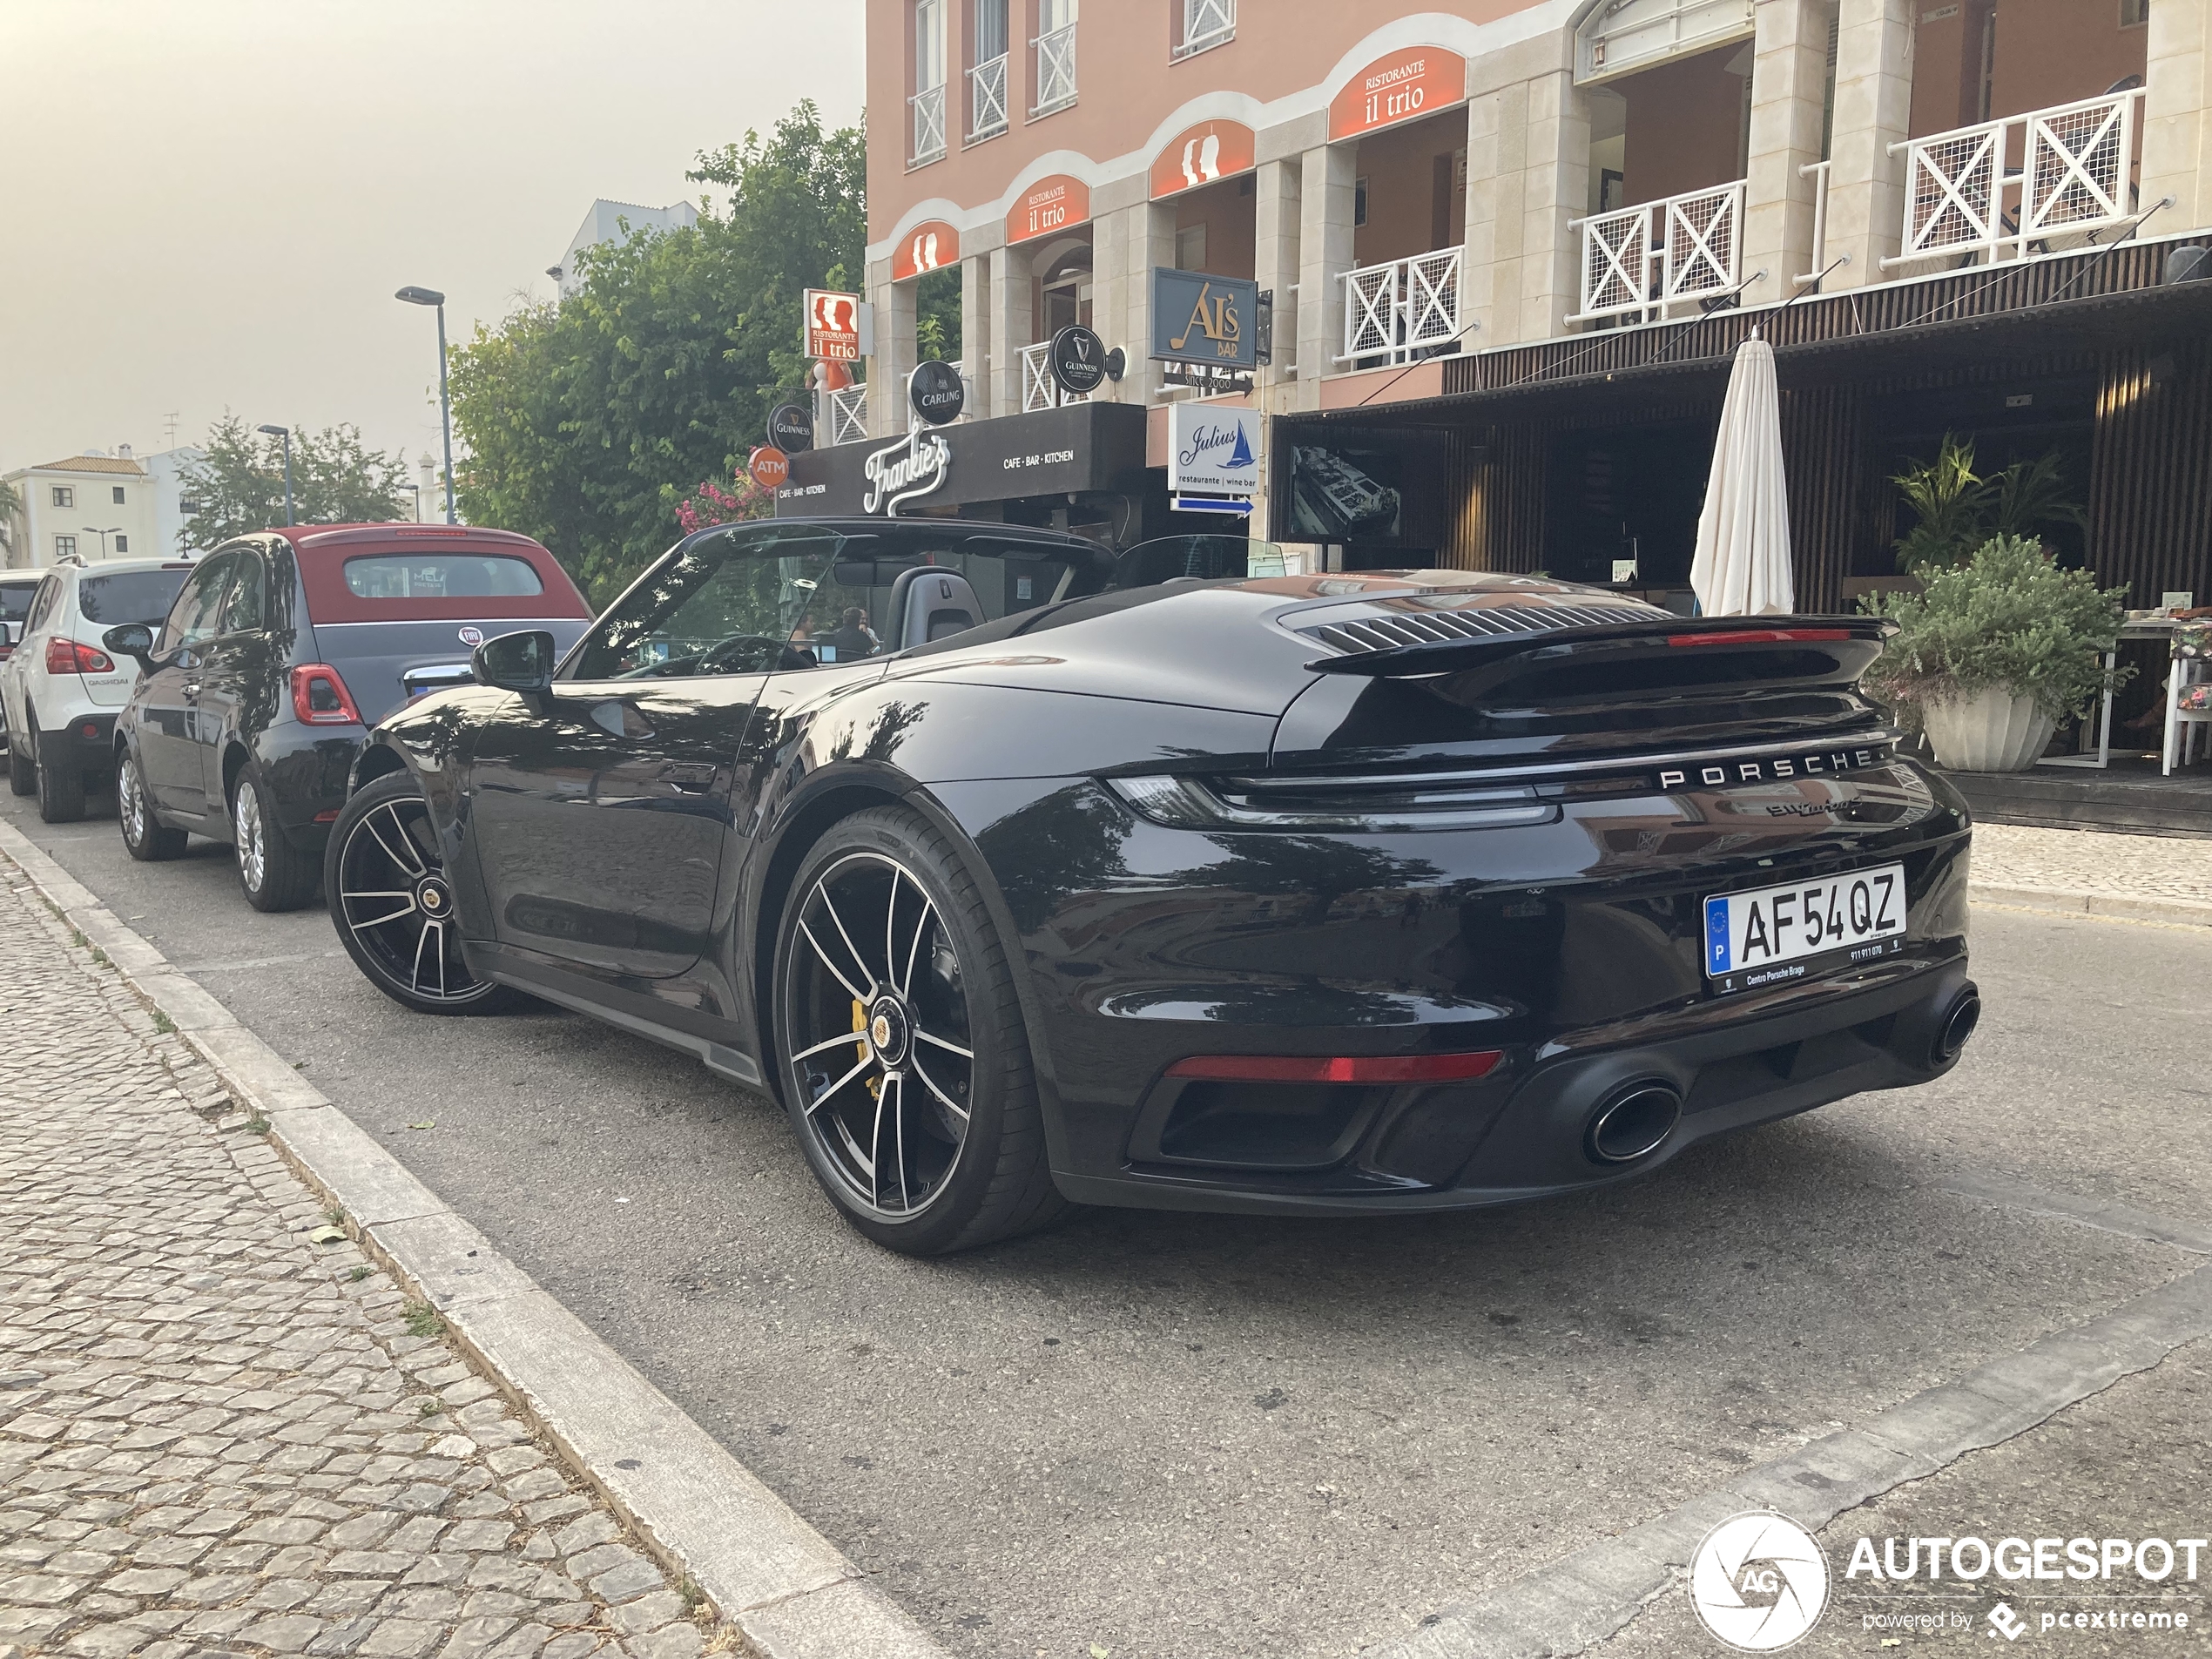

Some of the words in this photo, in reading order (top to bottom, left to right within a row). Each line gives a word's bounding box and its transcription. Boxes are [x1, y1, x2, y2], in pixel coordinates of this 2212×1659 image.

[1365, 59, 1425, 90] RISTORANTE
[1365, 94, 1379, 124] il
[1387, 84, 1424, 117] trio
[1028, 185, 1065, 206] RISTORANTE
[1029, 209, 1038, 232] il
[1042, 204, 1065, 228] trio
[813, 330, 856, 340] RISTORANTE
[813, 340, 824, 355] il
[830, 342, 856, 358] trio
[1217, 341, 1238, 358] BAR
[1066, 361, 1097, 372] GUINNESS
[1208, 377, 1231, 389] 2000
[921, 390, 960, 407] CARLING
[776, 423, 810, 435] GUINNESS
[1179, 425, 1236, 466] Julius
[757, 461, 785, 474] ATM
[864, 415, 951, 517] Frankie's
[1004, 458, 1021, 469] CAFE
[1025, 455, 1039, 466] BAR
[1045, 450, 1073, 464] KITCHEN
[1179, 475, 1220, 484] restaurante
[779, 489, 791, 499] CAFE
[794, 487, 803, 497] BAR
[806, 484, 826, 495] KITCHEN
[465, 632, 479, 641] FIAT
[1660, 750, 1871, 789] PORSCHE
[1716, 944, 1724, 960] P
[1747, 975, 1767, 985] Centro
[1767, 968, 1788, 981] Porsche
[1789, 966, 1804, 976] Braga
